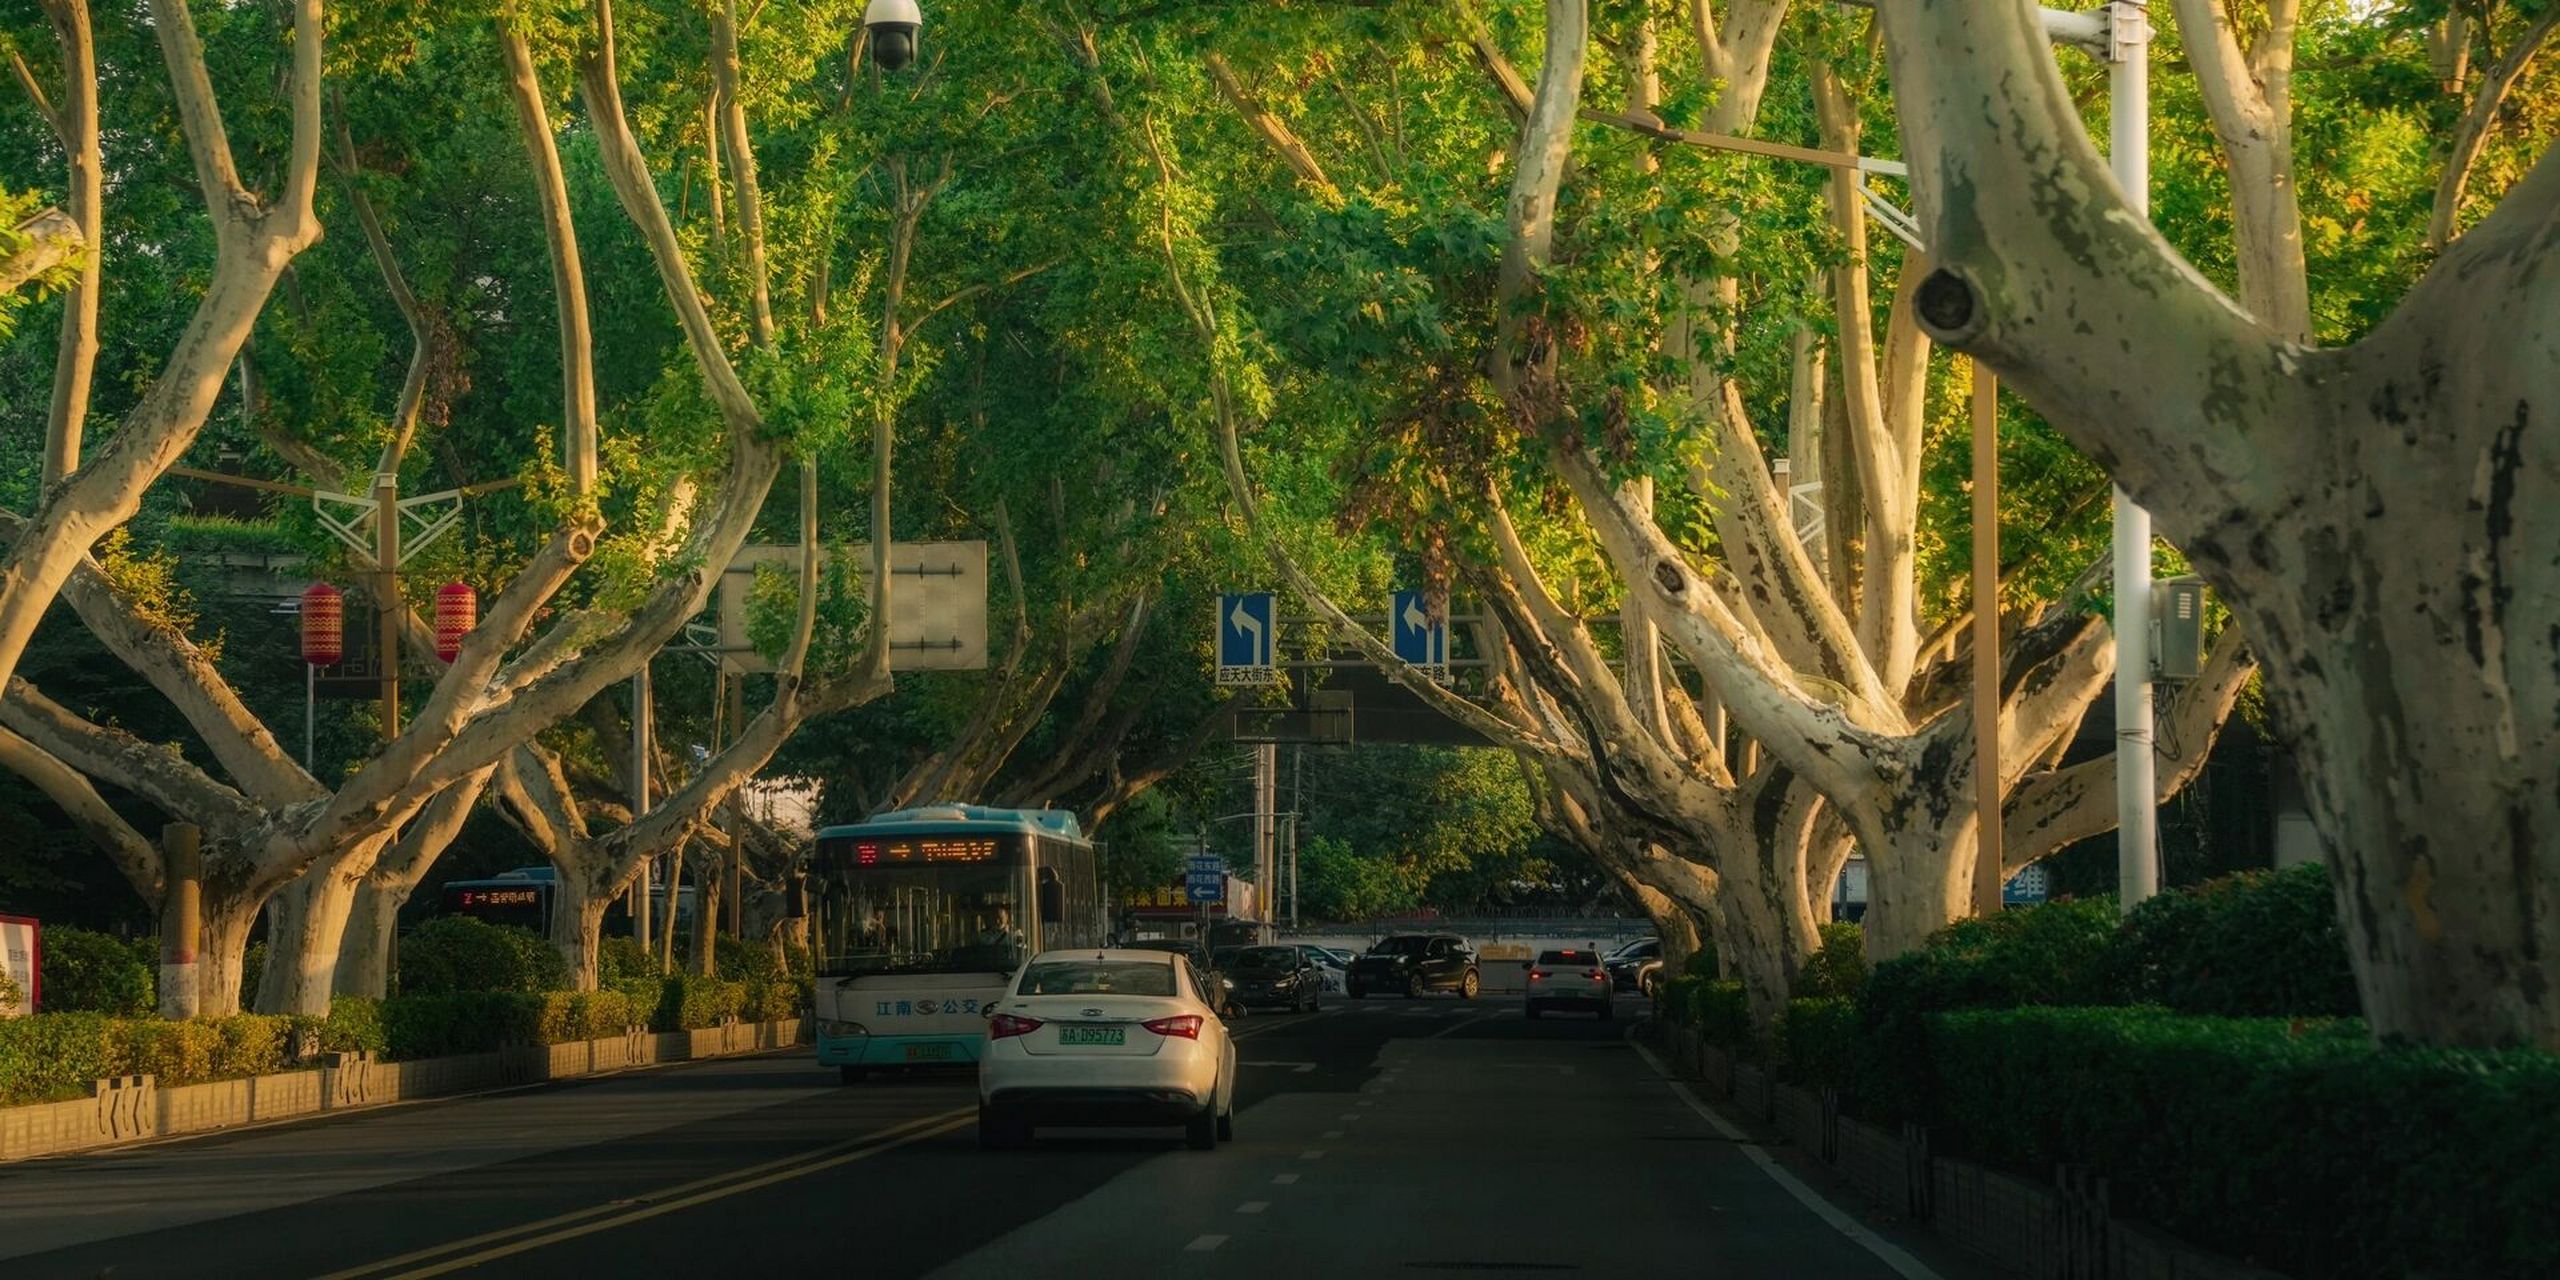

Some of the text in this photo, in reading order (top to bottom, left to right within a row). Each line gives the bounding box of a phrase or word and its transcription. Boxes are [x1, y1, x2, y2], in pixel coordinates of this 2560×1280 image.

[1220, 667, 1273, 681] 应天大街东
[877, 1000, 979, 1016] 江南 公交
